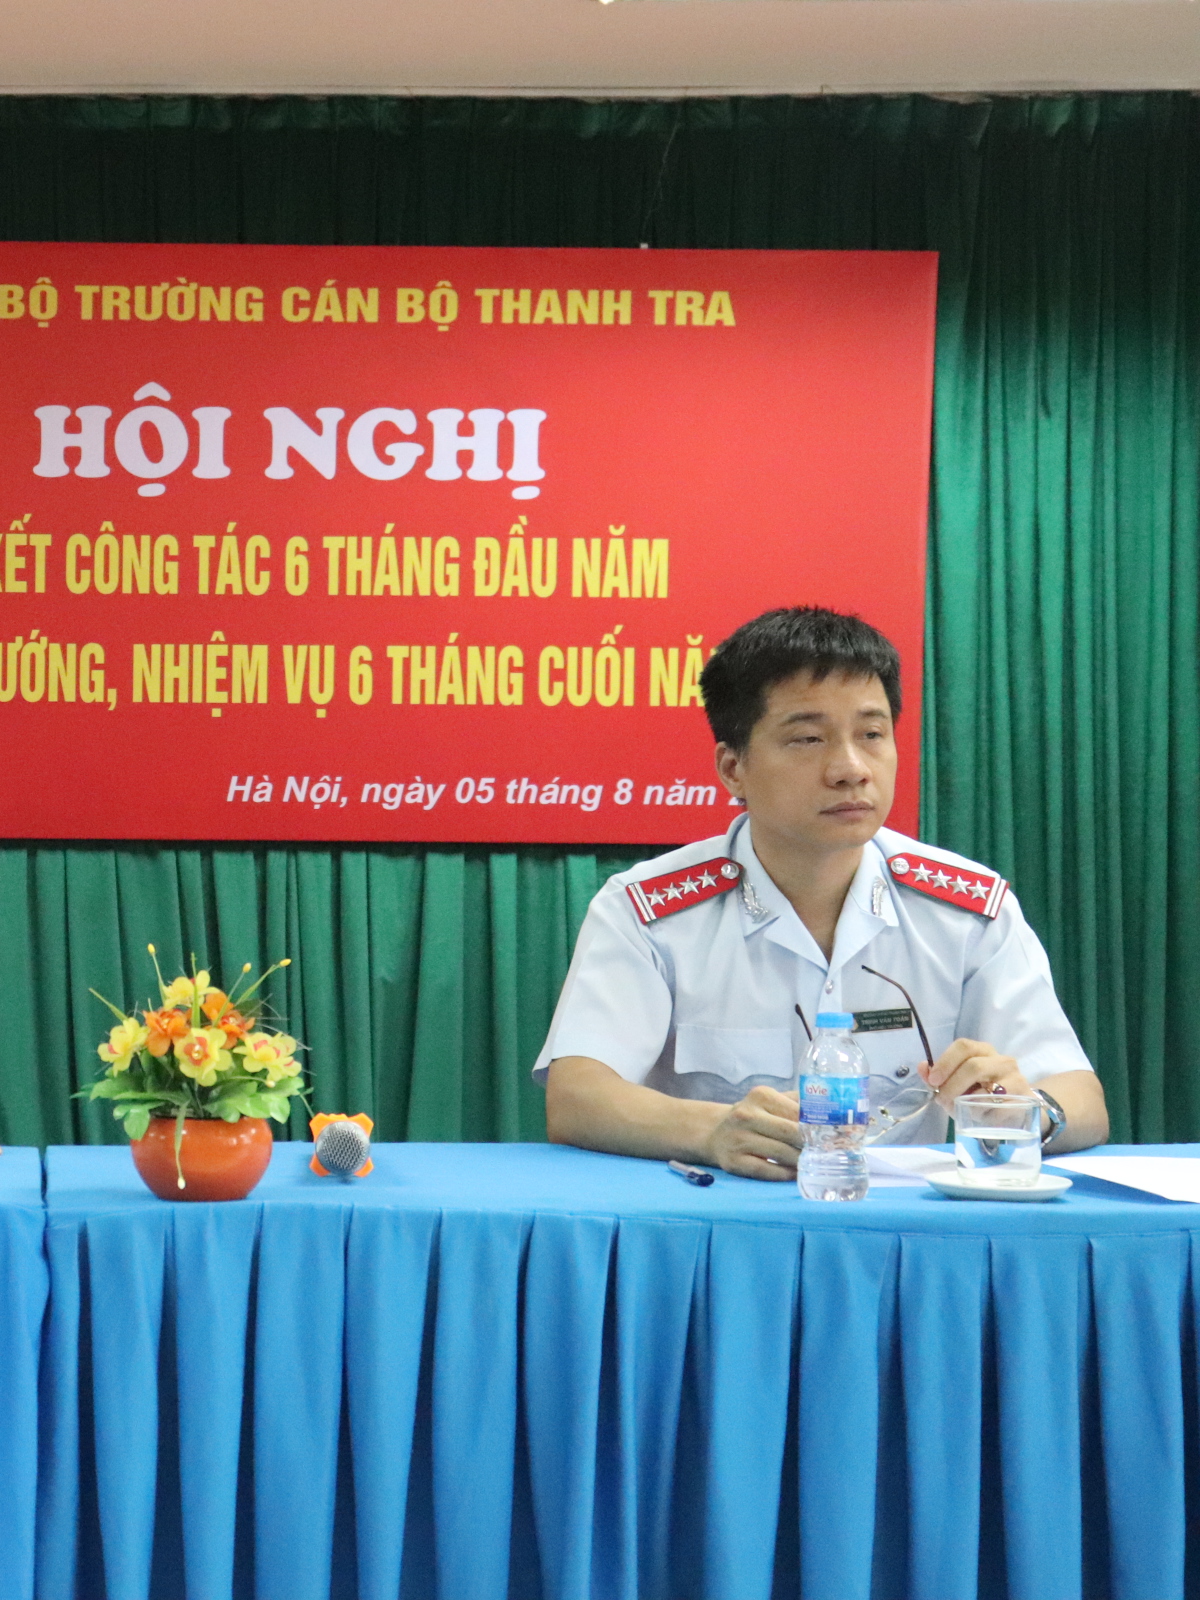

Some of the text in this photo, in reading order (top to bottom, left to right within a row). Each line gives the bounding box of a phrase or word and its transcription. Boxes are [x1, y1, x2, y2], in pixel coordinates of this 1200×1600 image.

[74, 276, 265, 323] TRƯỜNG
[280, 279, 380, 324] CÁN
[395, 279, 459, 333] BỘ
[473, 287, 633, 326] THANH
[647, 289, 737, 328] TRA
[33, 382, 549, 502] HỘI NGHỊ
[66, 521, 180, 596] CÔNG
[193, 522, 272, 597] TÁC
[285, 536, 311, 598] 6
[323, 523, 462, 599] THÁNG
[473, 515, 560, 600] ĐẦU
[572, 525, 671, 600] NĂM
[133, 631, 270, 719] NHIỆM
[283, 645, 336, 720] VỤ
[349, 645, 375, 707] 6
[387, 632, 525, 708] THÁNG
[539, 625, 637, 709] CUỐI
[649, 633, 717, 708] NĂ
[227, 775, 718, 813] Hà Nội, ngày 05 tháng 8 năm
